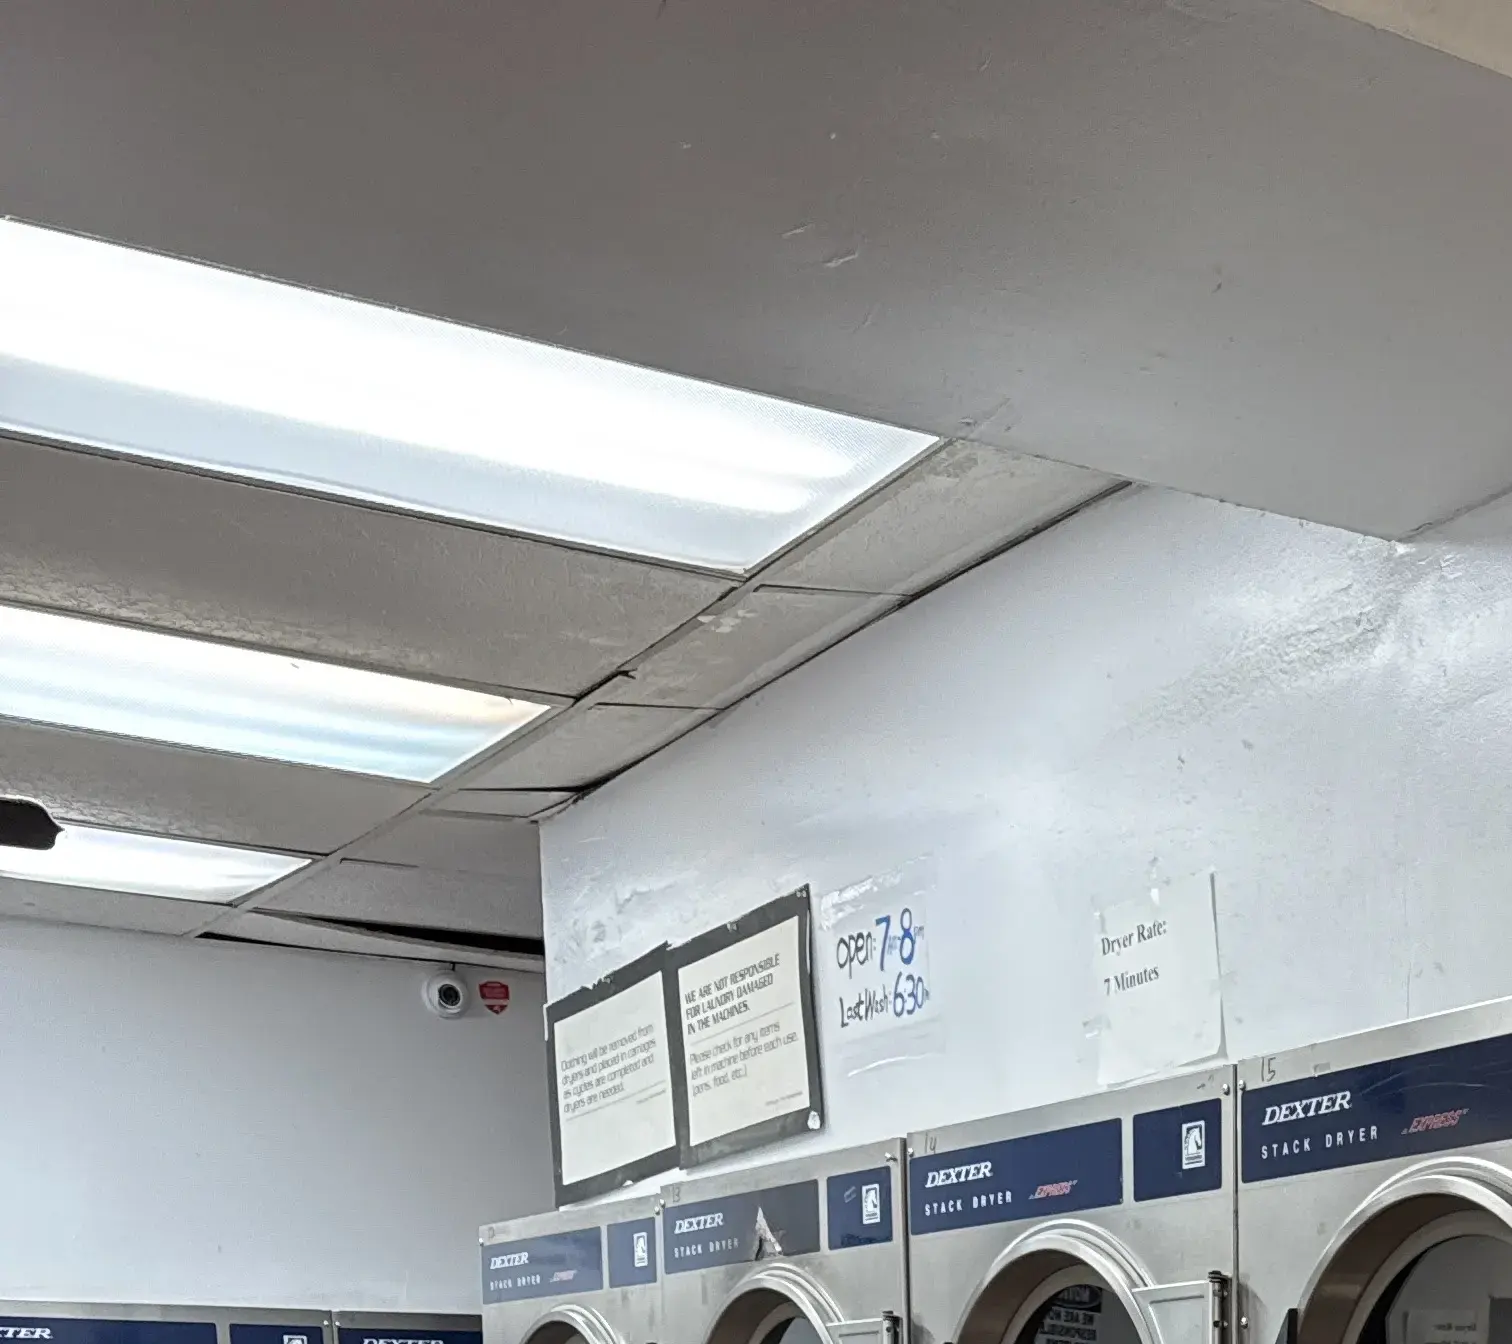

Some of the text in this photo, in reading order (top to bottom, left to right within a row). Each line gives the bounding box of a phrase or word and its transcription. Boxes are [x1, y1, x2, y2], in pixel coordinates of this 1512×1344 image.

[1101, 919, 1167, 956] Dryer Rate:
[685, 953, 780, 1004] WE ARE NOT RESPONSIBLE
[1103, 966, 1159, 996] 7 Minutes
[685, 972, 774, 1020] FOR LAUNDRY DAMAGED
[687, 1022, 696, 1036] IN
[698, 1015, 711, 1031] THE
[1262, 1090, 1351, 1126] DEXTER
[1261, 1125, 1378, 1160] STACK DRYER
[925, 1161, 992, 1188] DEXTER
[925, 1190, 1012, 1217] STACK DRYER
[674, 1212, 724, 1234] DEXTER
[490, 1251, 529, 1270] DEXTER
[674, 1243, 702, 1258] STACK
